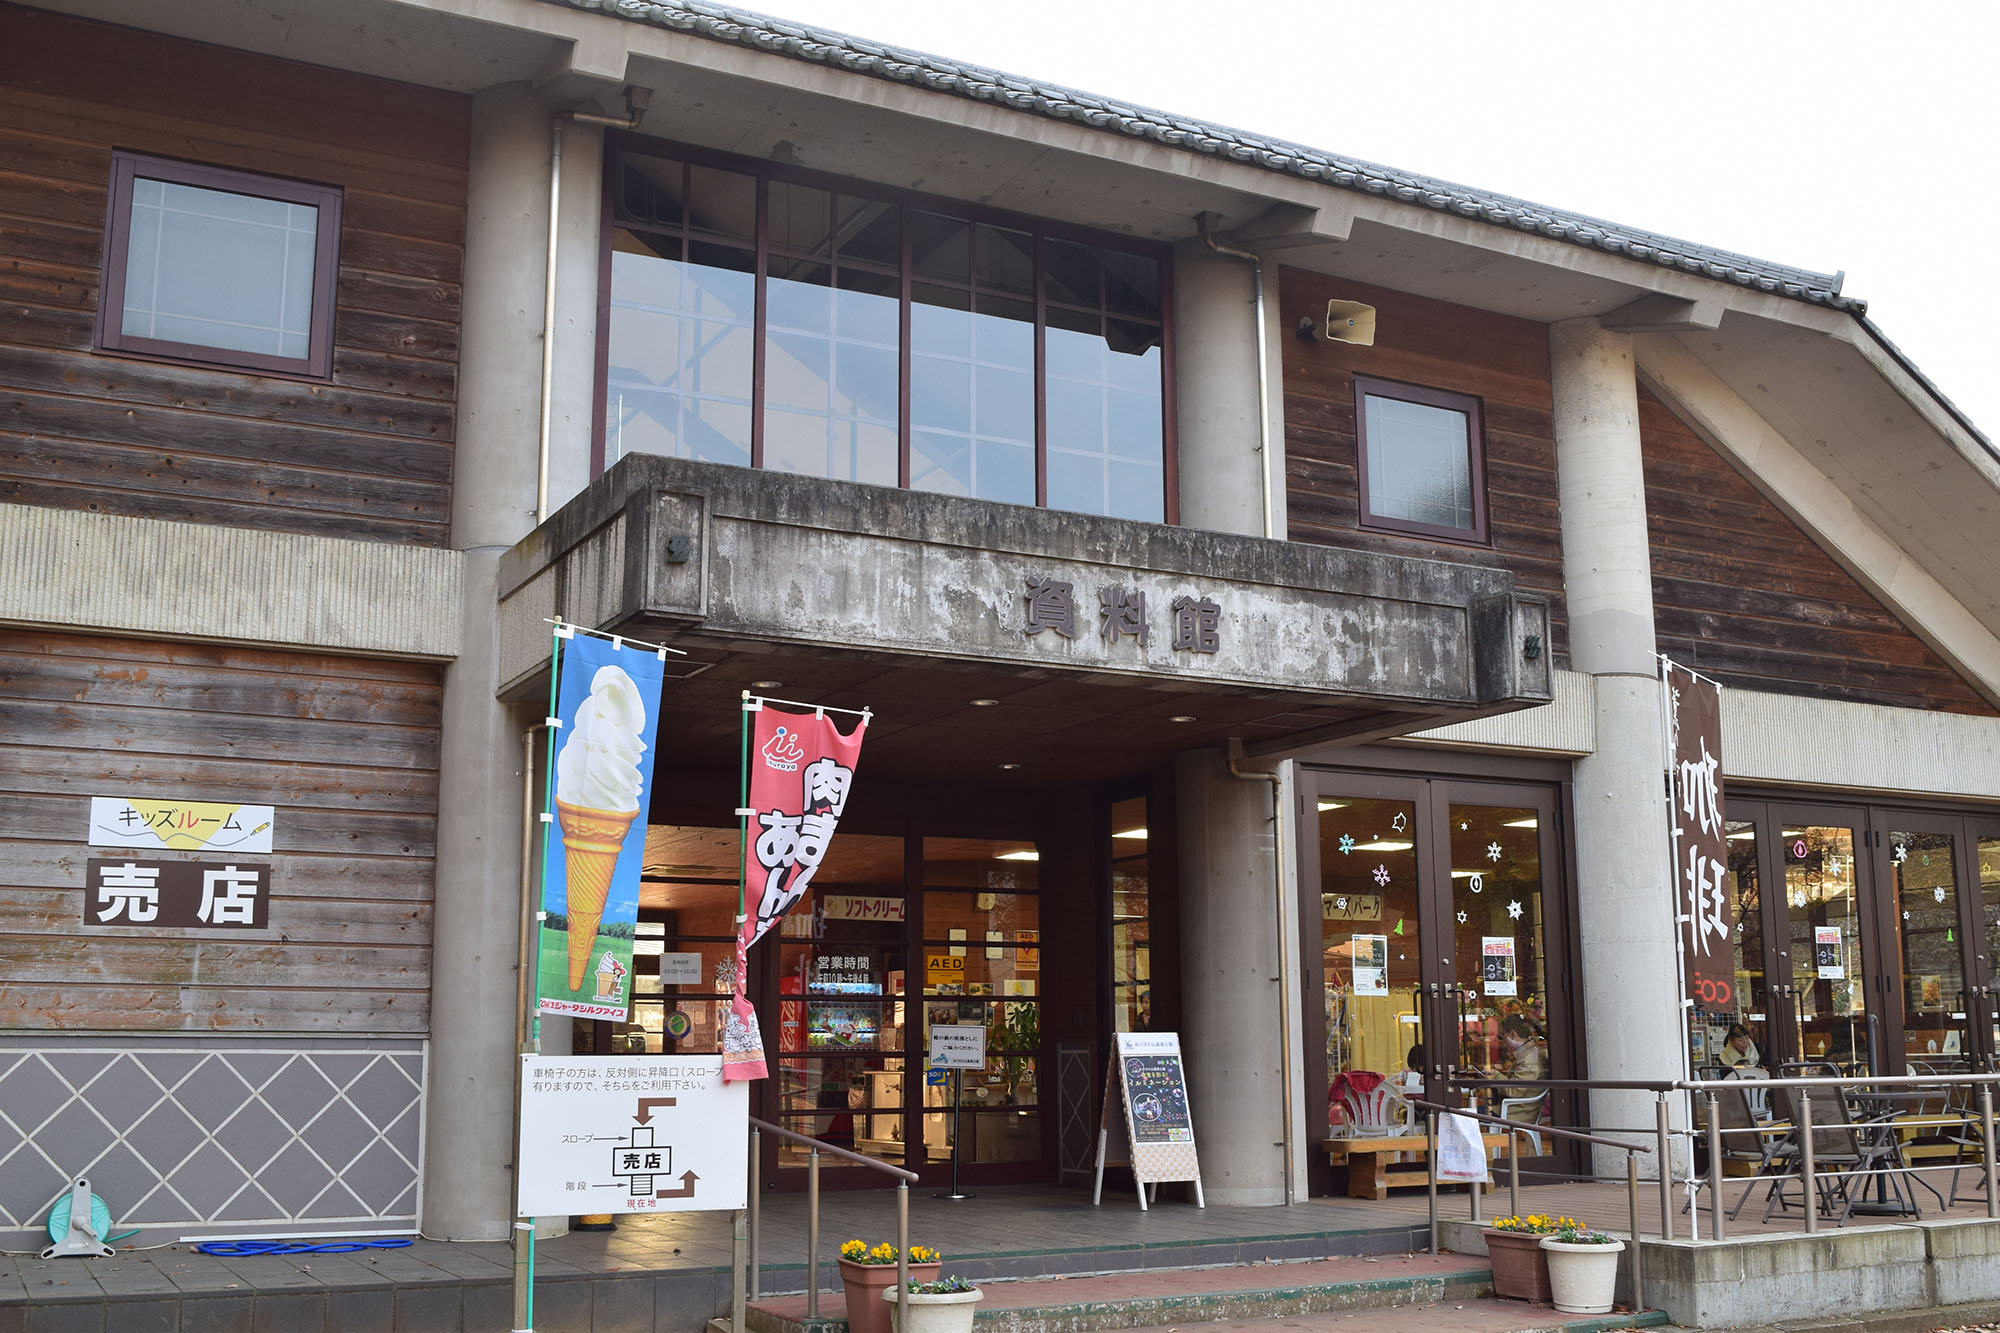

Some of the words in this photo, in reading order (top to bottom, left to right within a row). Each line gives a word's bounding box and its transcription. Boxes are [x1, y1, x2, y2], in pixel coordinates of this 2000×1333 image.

[1024, 575, 1222, 655] 資料館
[118, 807, 242, 831] キッズルーム
[97, 862, 260, 925] 売店
[817, 956, 870, 970] 営業時間
[929, 958, 963, 968] AED
[561, 1134, 594, 1144] スロープ
[623, 1153, 662, 1170] 売店
[565, 1181, 587, 1192] 階段
[626, 1199, 657, 1209] 現在地
